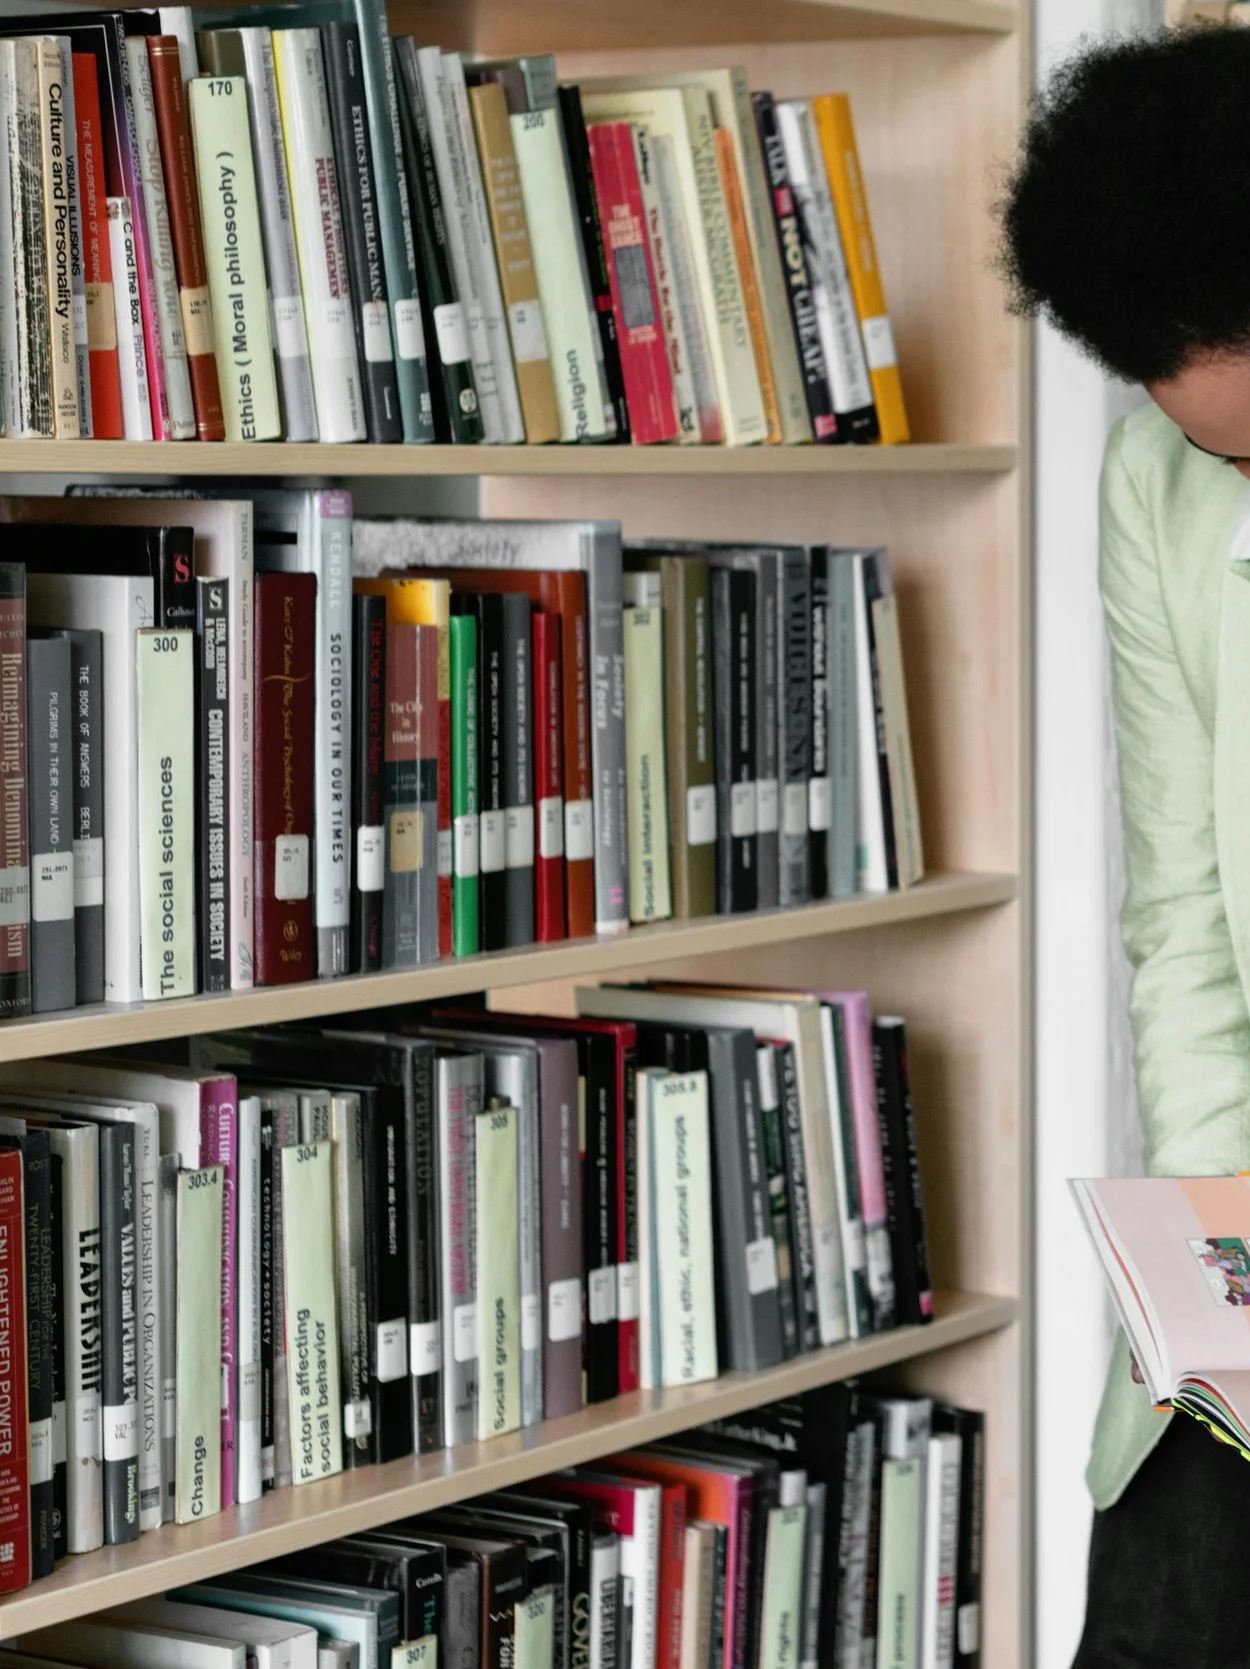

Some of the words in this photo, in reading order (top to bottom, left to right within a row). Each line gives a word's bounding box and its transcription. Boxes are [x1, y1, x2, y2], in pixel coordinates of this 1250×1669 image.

[382, 37, 393, 79] ETHICS
[208, 81, 233, 96] 170
[387, 83, 401, 153] CHALLENGE
[48, 83, 64, 157] Culture
[82, 119, 91, 139] THE
[352, 105, 367, 163] ETHICS
[51, 161, 66, 199] and
[66, 154, 76, 202] VISUAL
[84, 143, 96, 217] MEASUREMENT
[315, 157, 329, 205] PUBLIC
[359, 167, 370, 198] FOR
[397, 171, 408, 213] PUBLIC
[68, 204, 80, 276] ILLUSIONS
[89, 221, 97, 233] OF
[124, 221, 134, 234] C
[125, 238, 136, 266] and
[219, 166, 244, 284] philosophy
[321, 209, 339, 299] MANAGEMEN
[362, 201, 377, 260] PUBLIC
[401, 217, 414, 269] SERVICE
[781, 217, 807, 284] NOT
[52, 204, 70, 319] Personality
[127, 271, 138, 294] the
[129, 298, 140, 324] Box
[232, 293, 246, 353] Moral
[62, 322, 70, 364] Wallace
[132, 333, 144, 377] Prince
[238, 375, 257, 441] Ethics
[566, 348, 589, 440] Religion
[329, 531, 342, 607] KENDALL
[153, 637, 178, 652] 300
[79, 665, 89, 685] THE
[79, 690, 89, 717] BOOK
[330, 632, 342, 730] SOCIOLOGY
[1, 653, 22, 771] Reimagining
[49, 691, 58, 738] PILGRIMS
[79, 722, 89, 737] OF
[391, 702, 405, 715] The
[50, 742, 58, 753] IN
[50, 757, 59, 786] THEIR
[80, 742, 90, 788] ANSWERS
[208, 708, 223, 823] CONTEMPORARY
[331, 740, 342, 755] IN
[50, 790, 59, 814] OWN
[159, 756, 174, 863] sciences
[242, 750, 250, 857] ANTHROPOLOGY
[331, 764, 342, 800] OUR
[640, 753, 652, 853] interaction
[50, 818, 59, 845] LAND
[210, 827, 224, 877] ISSUES
[331, 807, 343, 863] TIMES
[159, 871, 174, 941] social
[210, 881, 224, 897] IN
[643, 858, 656, 918] Social
[210, 900, 224, 961] SOCIETY
[160, 953, 175, 995] The
[416, 1051, 431, 1195] POPULATION
[673, 1114, 689, 1182] groups
[188, 1173, 218, 1190] 303.4
[297, 1146, 318, 1162] 304
[142, 1180, 154, 1284] LEADERSHIP
[678, 1187, 692, 1260] national
[28, 1202, 39, 1312] TWENTY-FIRST
[40, 1227, 49, 1317] LEADERSHIP
[120, 1223, 135, 1287] VALUES
[0, 1225, 10, 1373] ENLIGHTENED
[79, 1226, 100, 1393] LEADERSHIP
[122, 1289, 136, 1318] and
[143, 1289, 154, 1306] IN
[264, 1280, 272, 1344] society
[29, 1319, 40, 1391] CENTURY
[122, 1321, 137, 1382] PUBLIC
[296, 1308, 311, 1395] affecting
[494, 1297, 508, 1366] groups
[681, 1317, 696, 1379] Racial,
[143, 1312, 156, 1452] ORGANIZATIONS
[315, 1320, 328, 1410] behavior
[0, 1378, 12, 1454] POWER
[494, 1370, 507, 1430] Social
[299, 1402, 313, 1479] Factors
[319, 1414, 330, 1473] social
[125, 1465, 137, 1525] Brookings
[191, 1435, 206, 1516] Change
[527, 1602, 545, 1619] 320
[406, 1646, 427, 1664] 307
